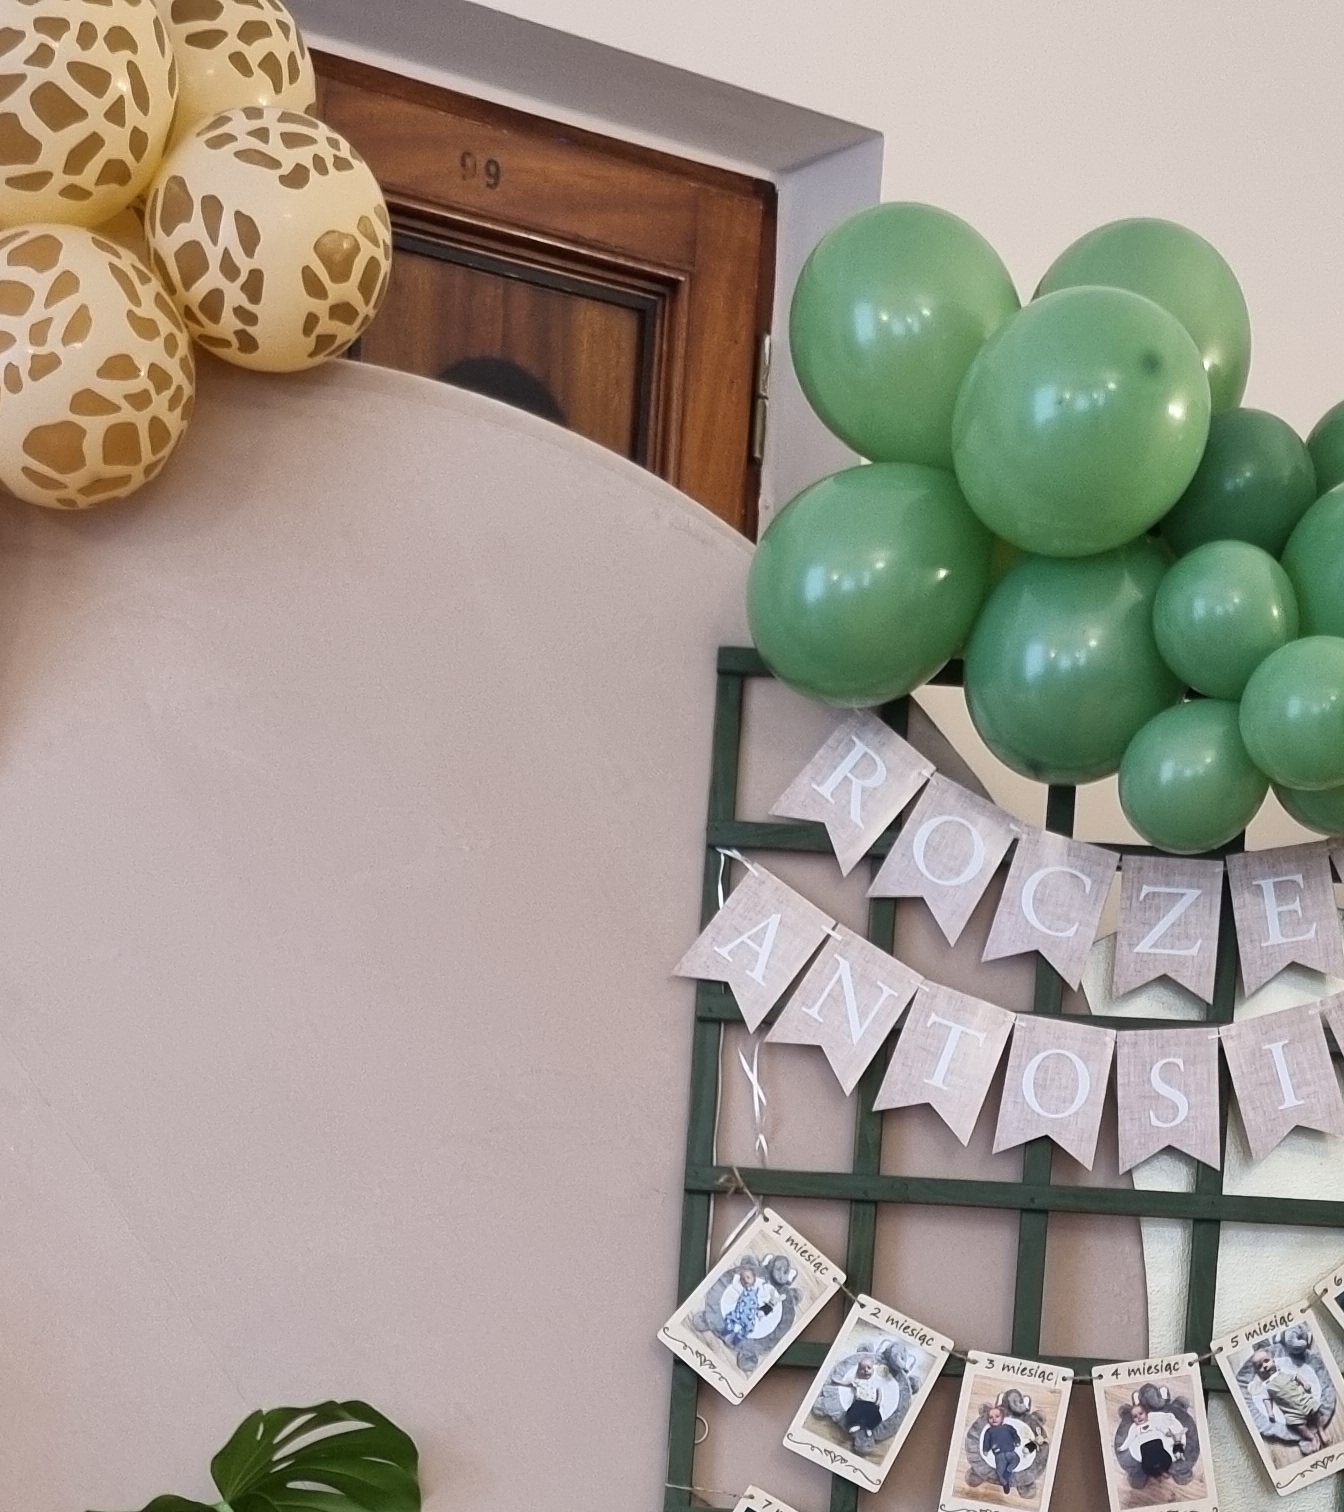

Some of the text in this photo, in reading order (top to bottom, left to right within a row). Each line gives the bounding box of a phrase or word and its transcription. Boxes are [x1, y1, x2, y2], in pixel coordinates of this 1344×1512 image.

[773, 1225, 829, 1275] 1 miesiąc
[1333, 1275, 1343, 1287] 6
[870, 1307, 935, 1348] 2 miesiąc
[1230, 1311, 1295, 1349] 5 miesiąc
[985, 1358, 1054, 1382] 3 miesiąc
[1110, 1360, 1180, 1379] 4 miesiąc
[761, 1498, 773, 1510] 7
